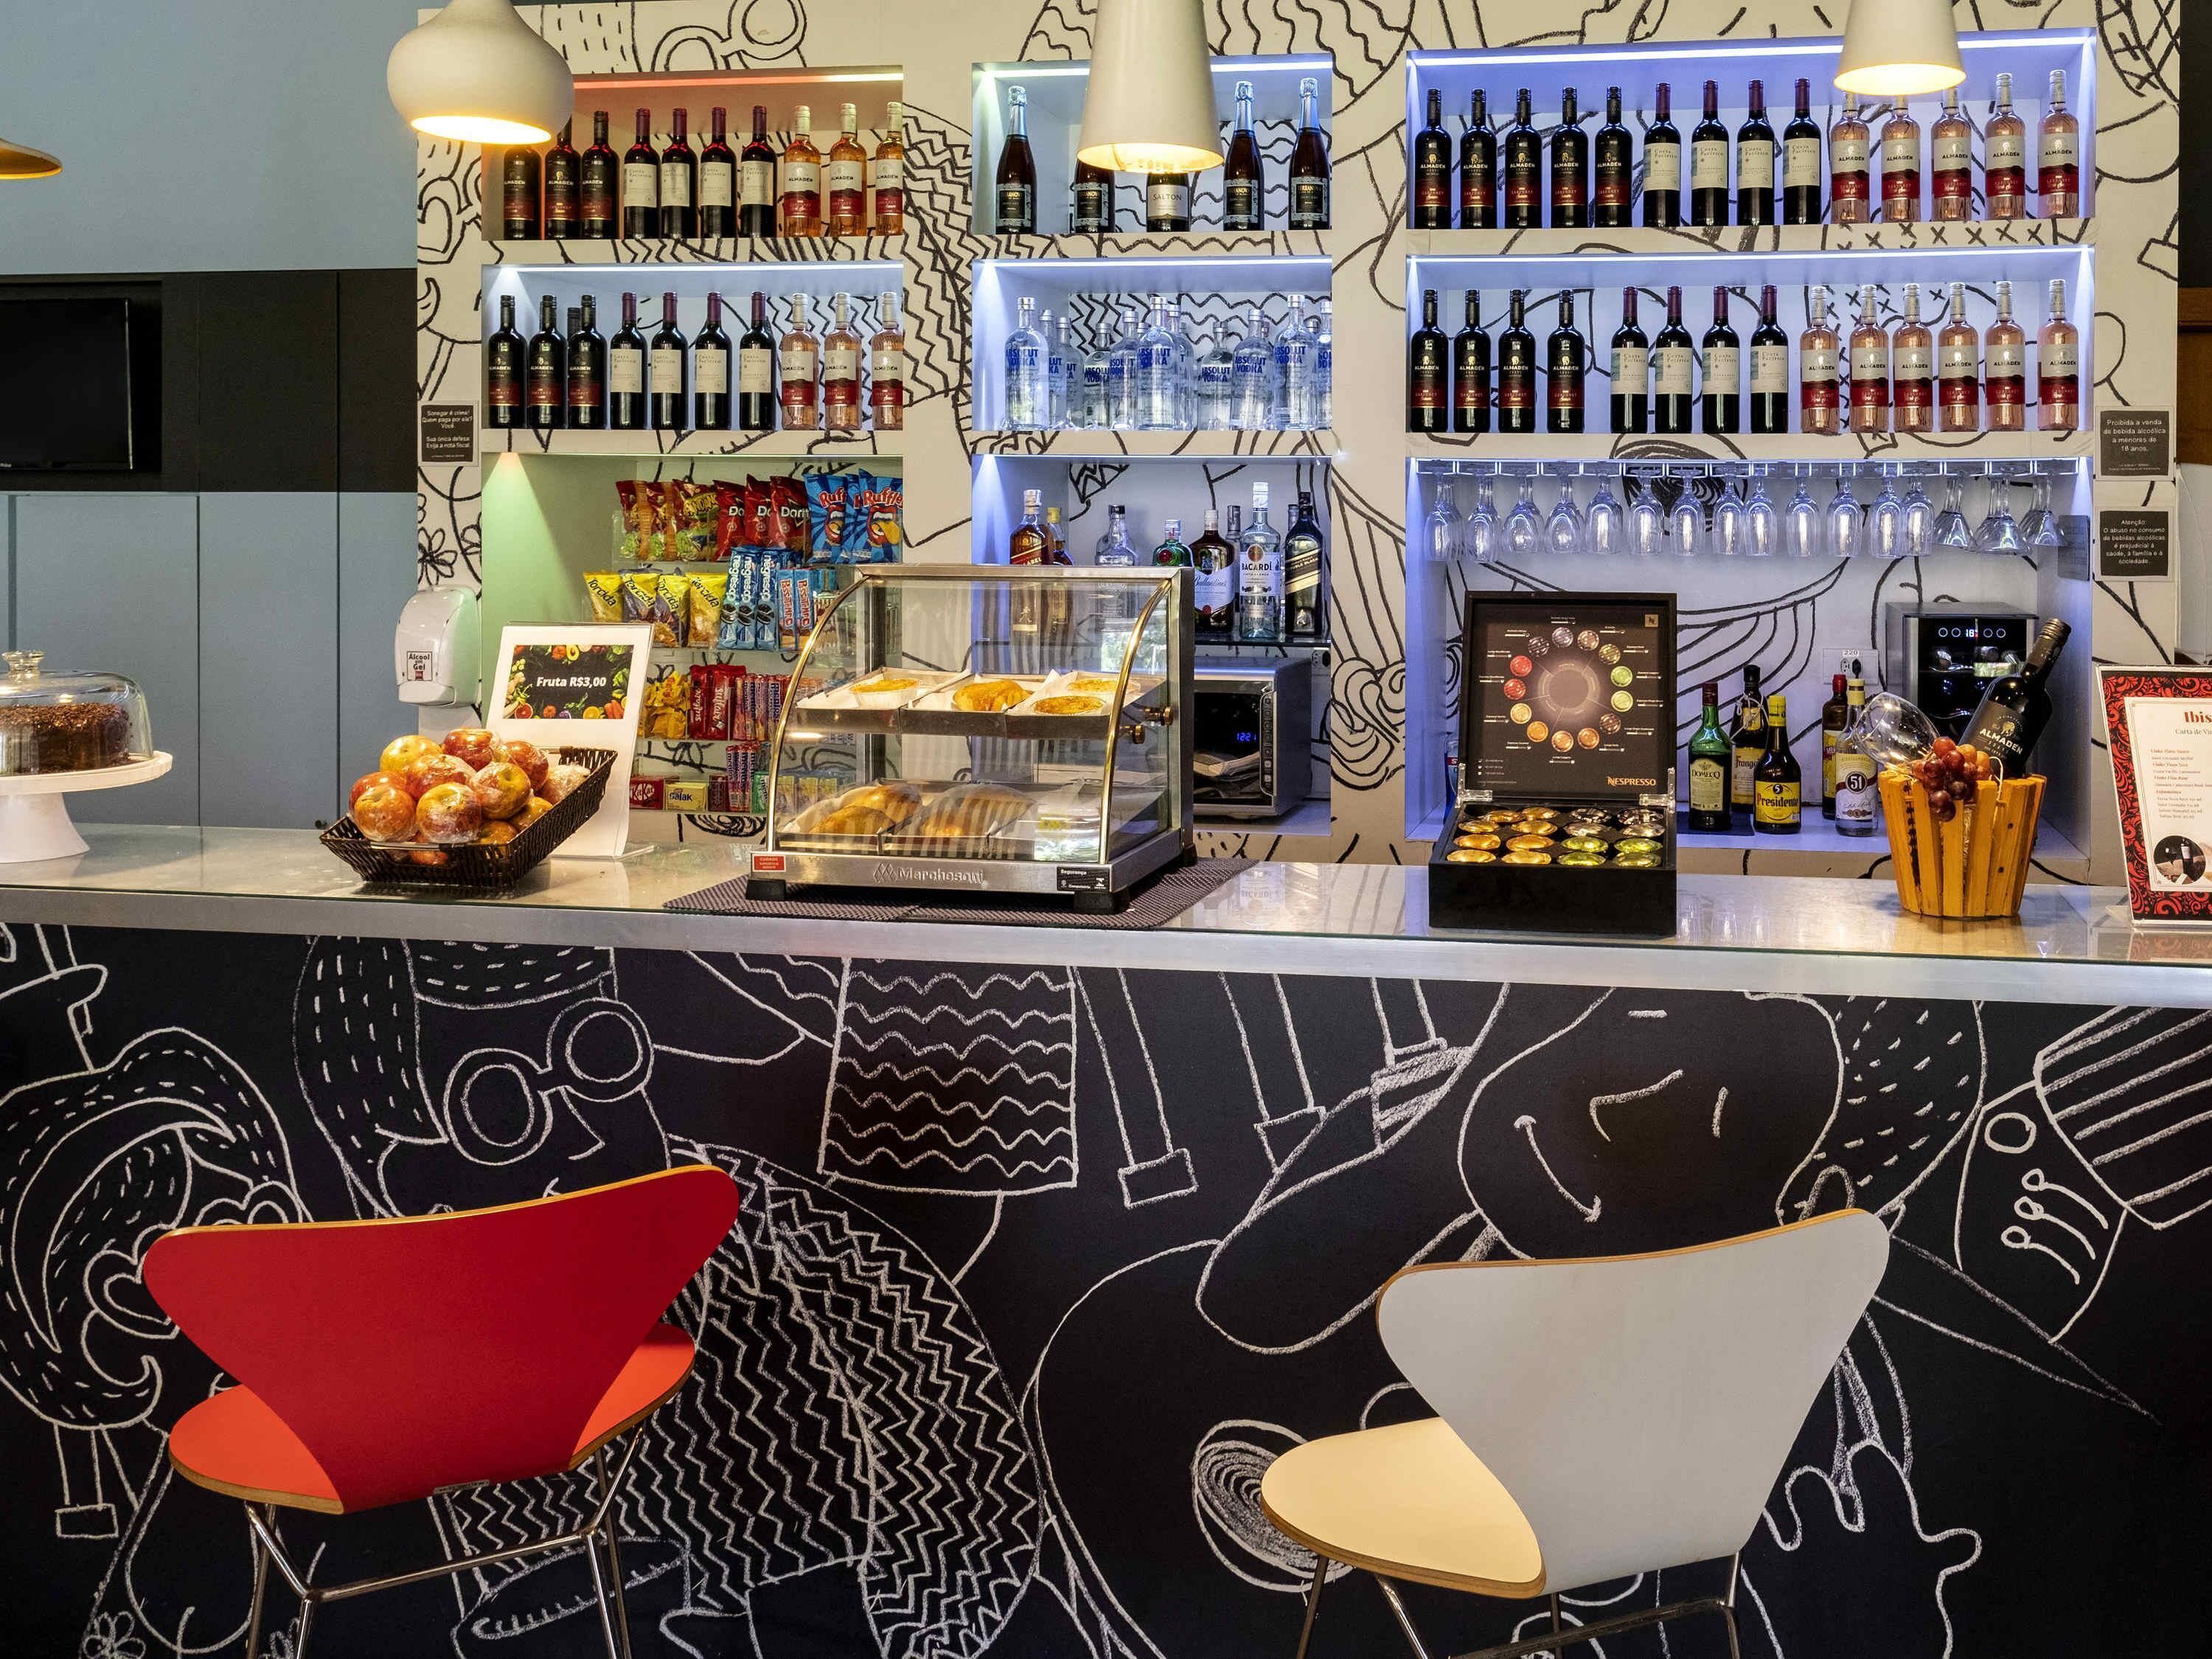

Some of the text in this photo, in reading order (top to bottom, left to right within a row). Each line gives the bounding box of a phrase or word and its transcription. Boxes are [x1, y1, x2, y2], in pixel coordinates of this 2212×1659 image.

[588, 579, 616, 607] Torcida
[625, 577, 655, 607] Torcida
[537, 677, 606, 688] Fruta R$3,00
[1605, 776, 1657, 787] NESPRESSO
[1851, 776, 1863, 790] 51
[1757, 793, 1798, 807] Presidente
